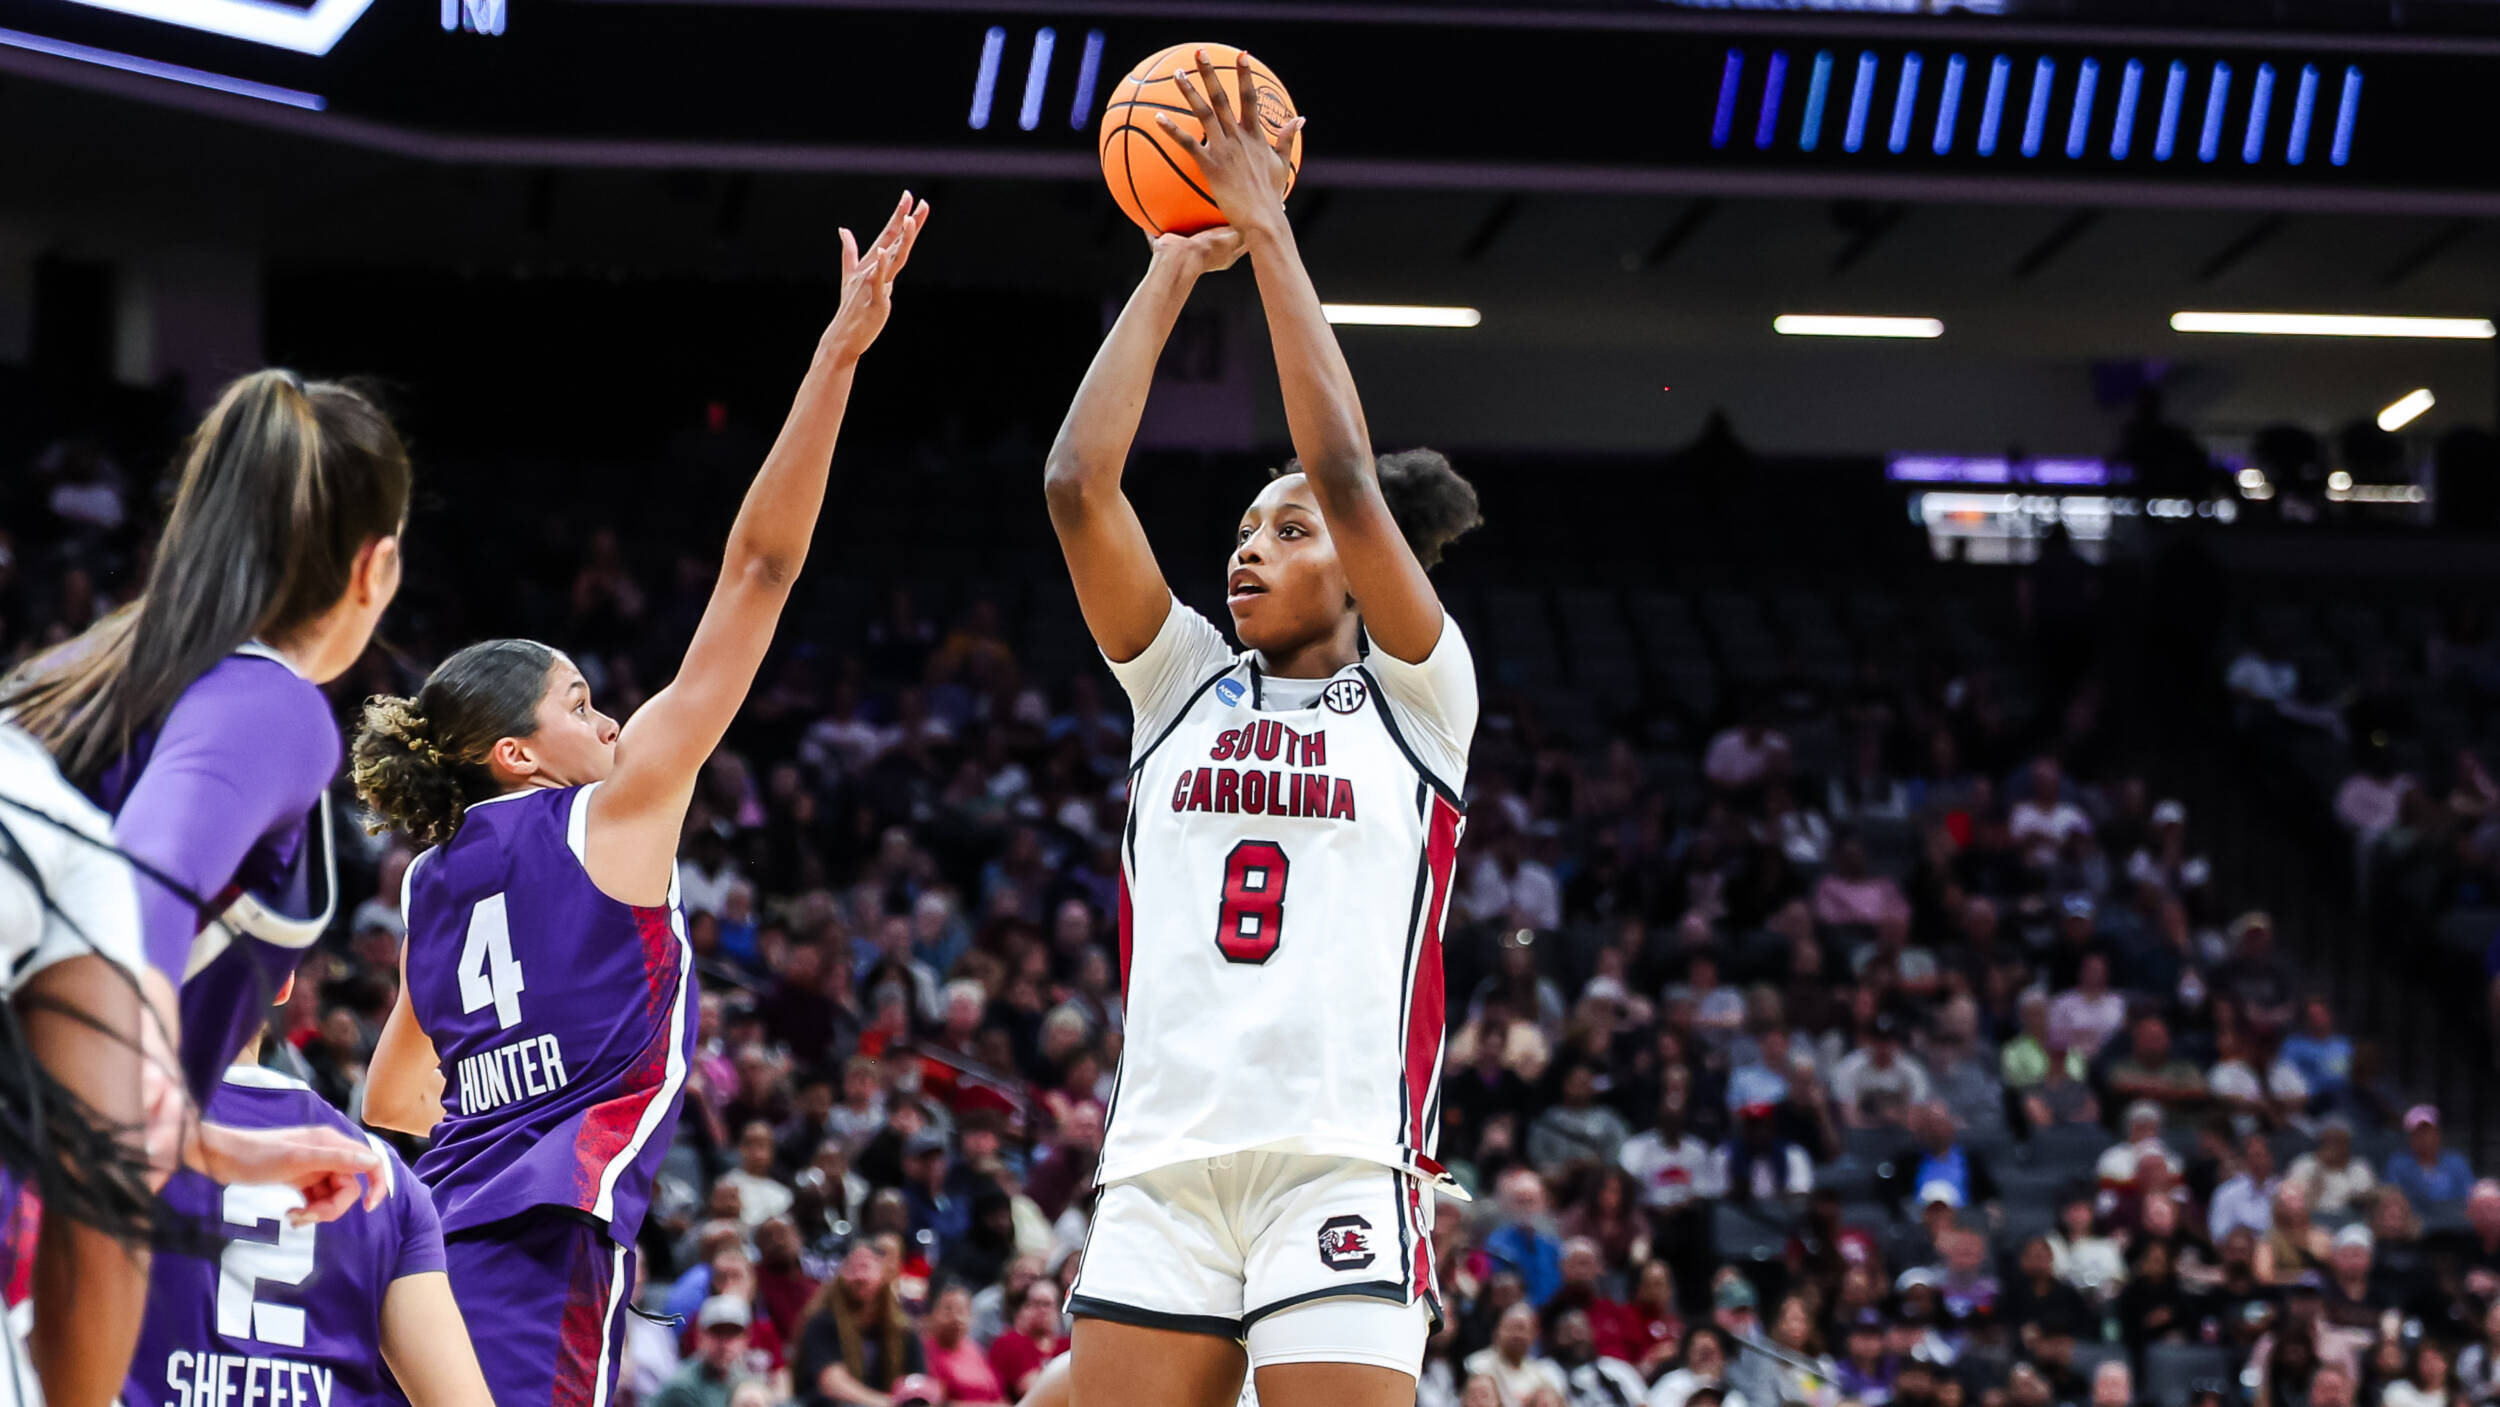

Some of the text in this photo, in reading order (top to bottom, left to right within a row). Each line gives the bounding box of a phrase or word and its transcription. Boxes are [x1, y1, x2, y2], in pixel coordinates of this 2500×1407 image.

[1325, 681, 1364, 712] SEC
[1209, 719, 1326, 767] SOUTH
[1171, 767, 1356, 822] CAROLINA
[1215, 839, 1290, 965] 8
[457, 891, 525, 1031] 4
[457, 1033, 568, 1116] HUNTER
[217, 1182, 316, 1348] 2
